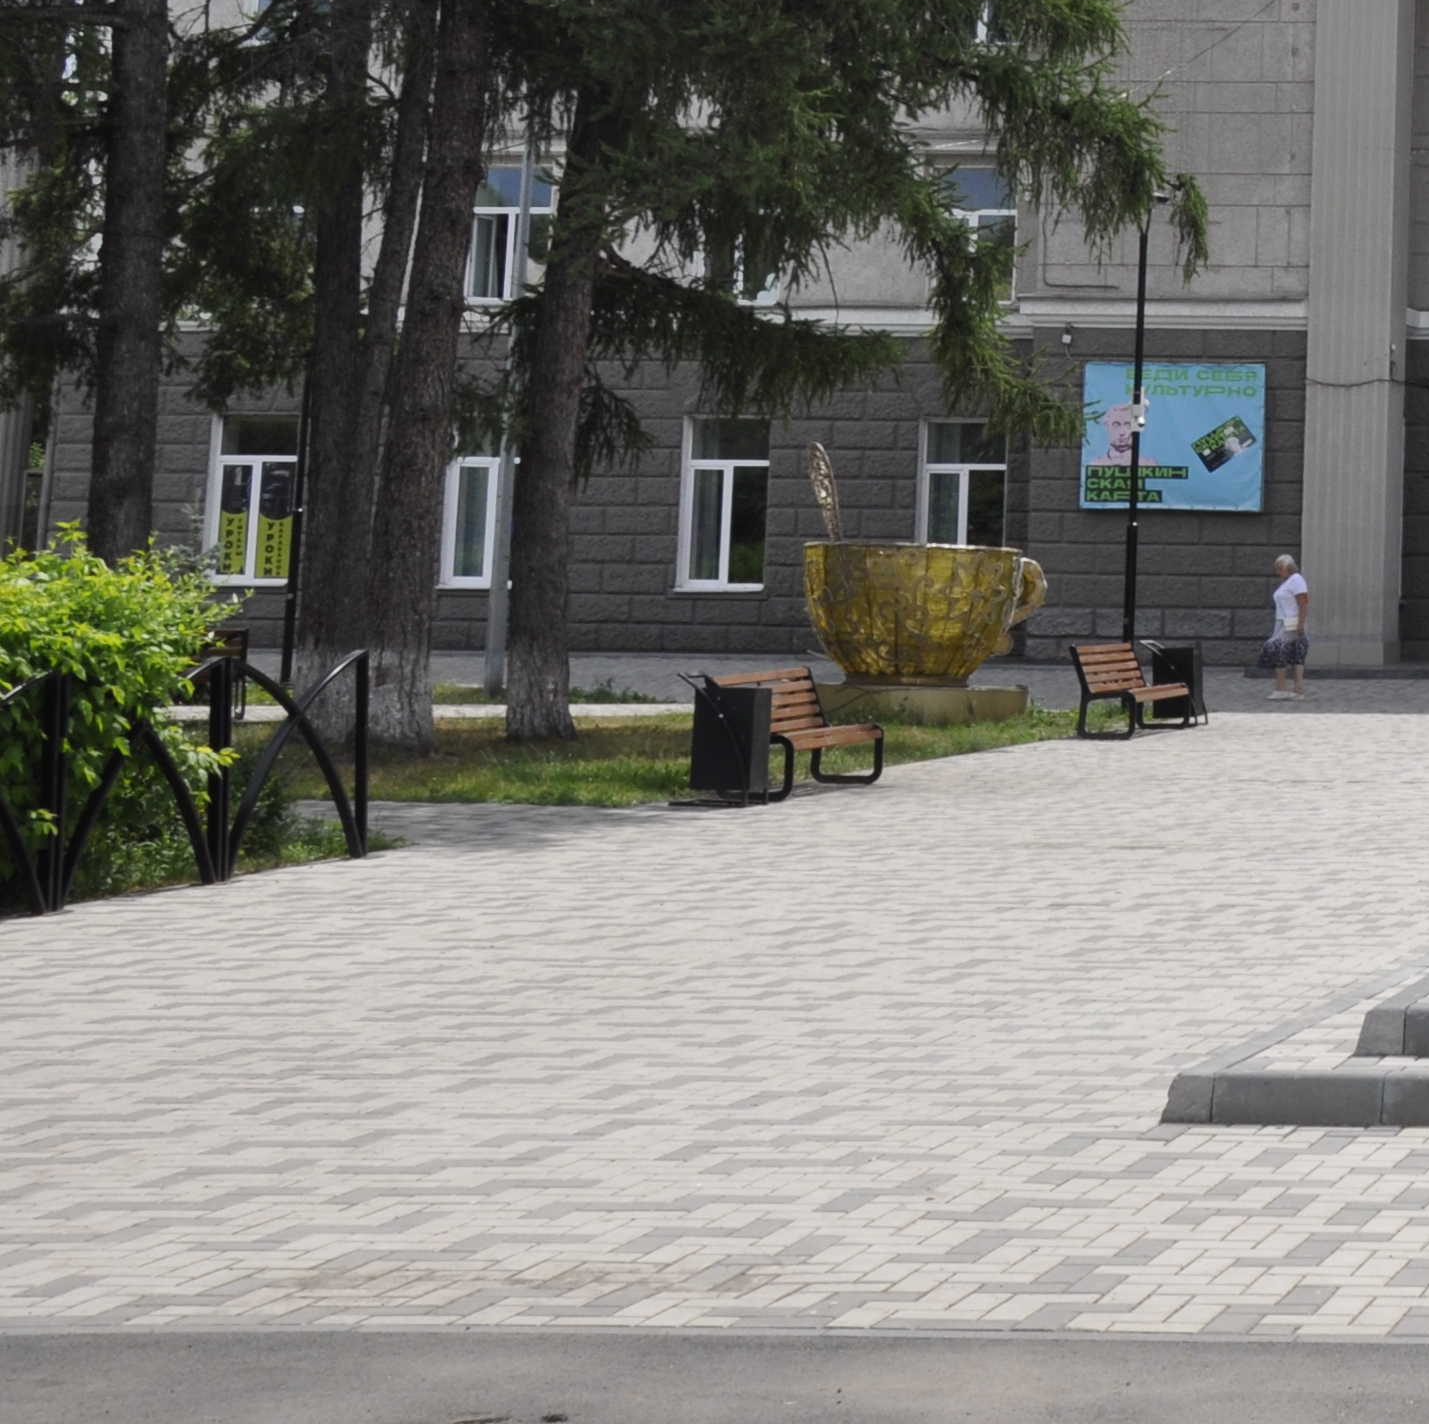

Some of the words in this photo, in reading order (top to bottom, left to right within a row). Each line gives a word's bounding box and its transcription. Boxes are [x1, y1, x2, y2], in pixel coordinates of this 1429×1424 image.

[1197, 369, 1258, 382] СЕБЯ
[1087, 466, 1187, 477] ПУШКИН
[1086, 490, 1160, 502] КАРТА
[222, 518, 235, 571] УРОКИ
[263, 522, 275, 576] УРОКИ
